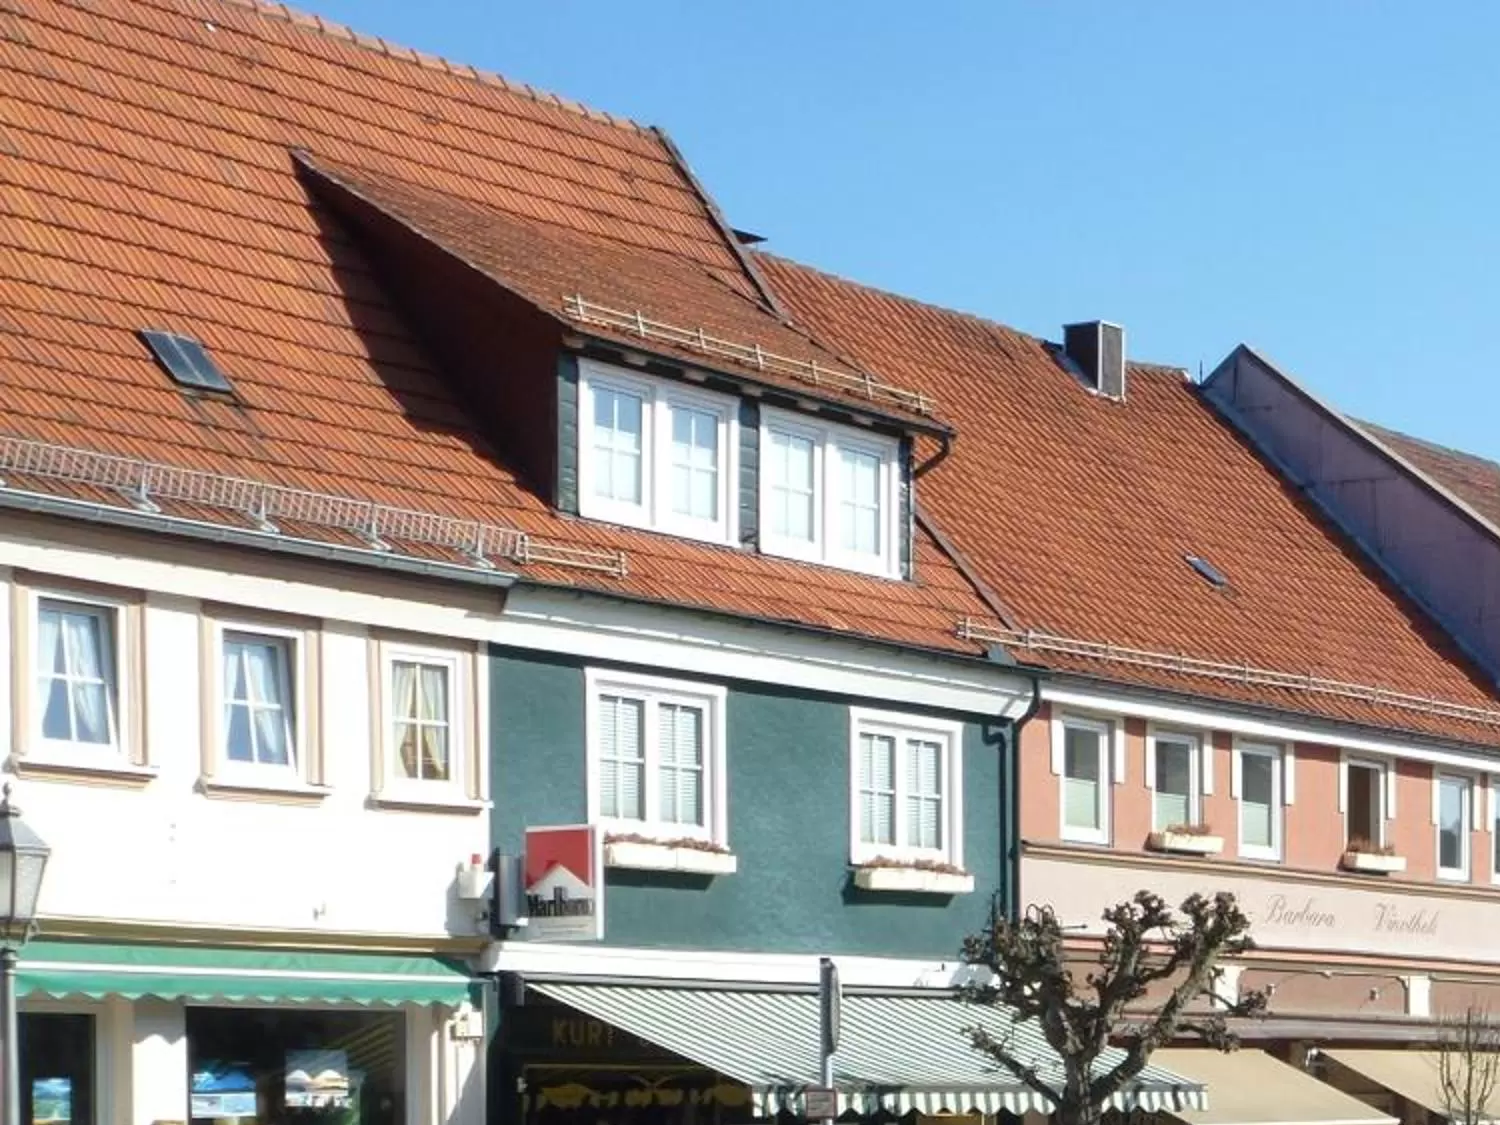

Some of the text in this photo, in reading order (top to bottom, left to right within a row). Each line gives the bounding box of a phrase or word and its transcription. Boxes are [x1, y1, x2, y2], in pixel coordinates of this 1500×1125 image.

[527, 887, 594, 917] Marlboro
[1265, 894, 1440, 935] Barbara Vinothek
